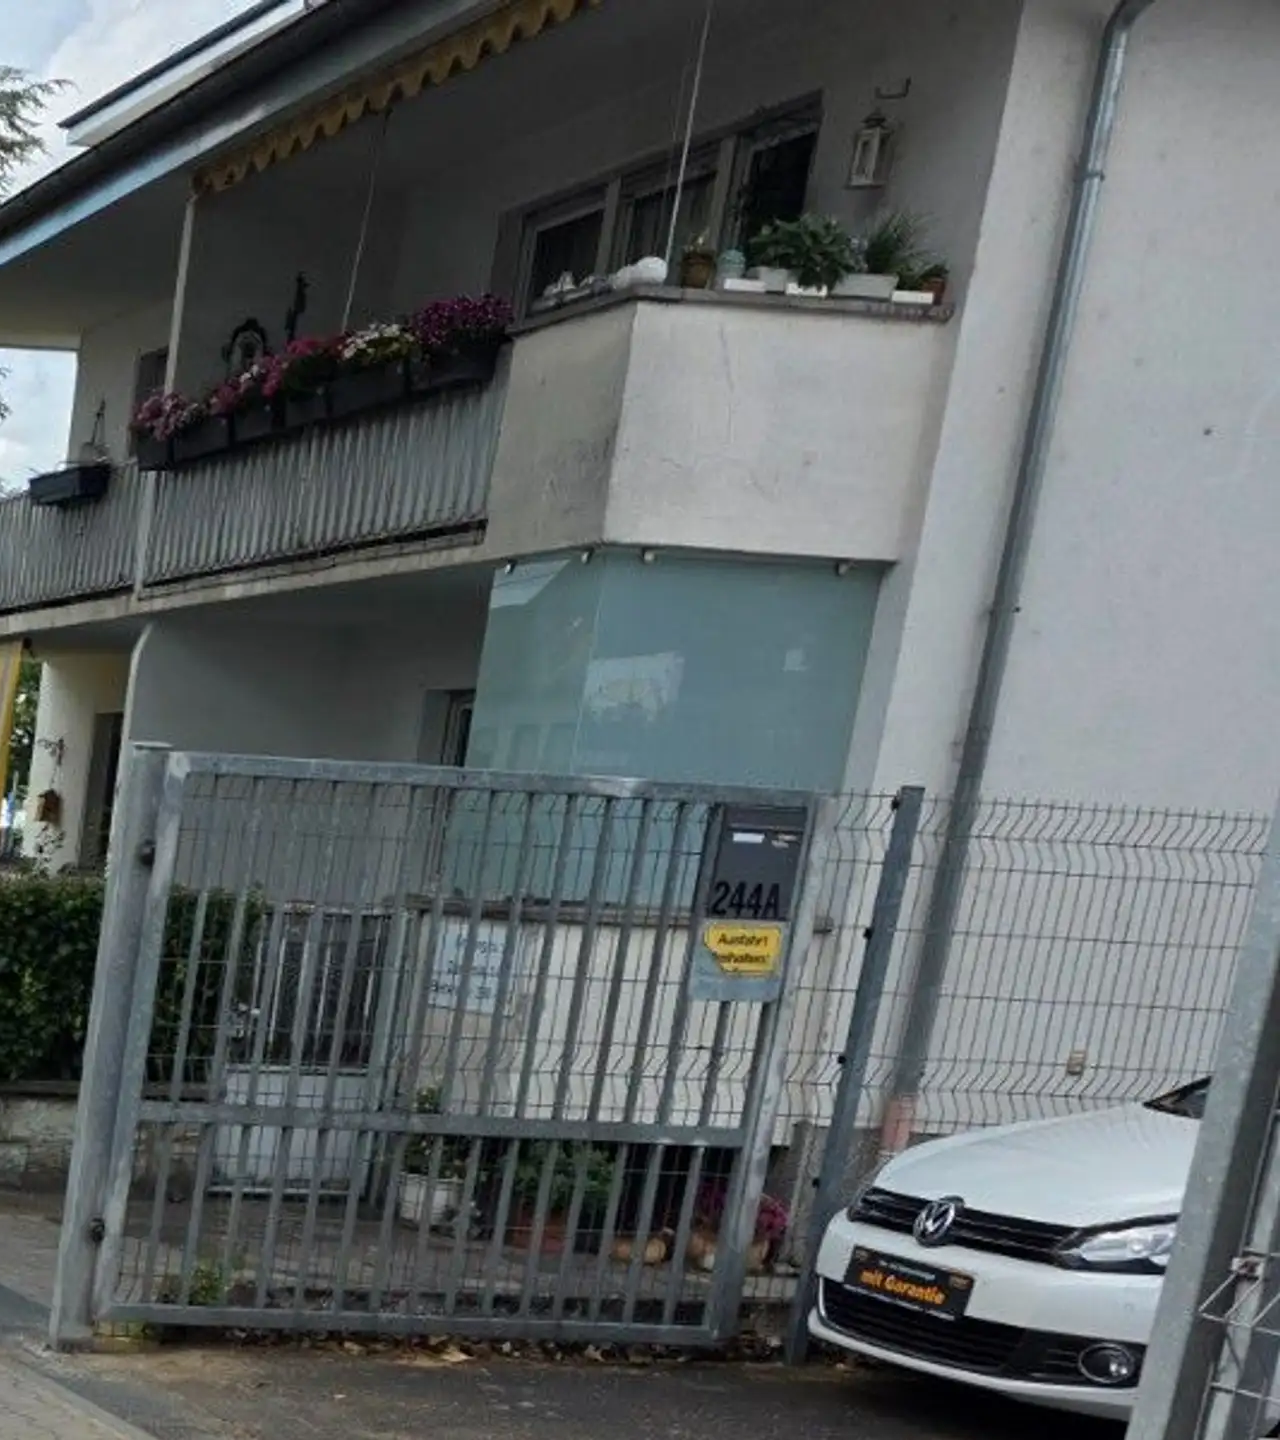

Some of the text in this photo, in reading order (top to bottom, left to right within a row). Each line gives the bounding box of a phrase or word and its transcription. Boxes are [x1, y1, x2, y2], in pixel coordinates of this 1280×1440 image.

[711, 881, 780, 918] 244A
[717, 933, 768, 946] Ausfahrt
[860, 1269, 883, 1288] mit
[884, 1275, 946, 1305] Garantie
